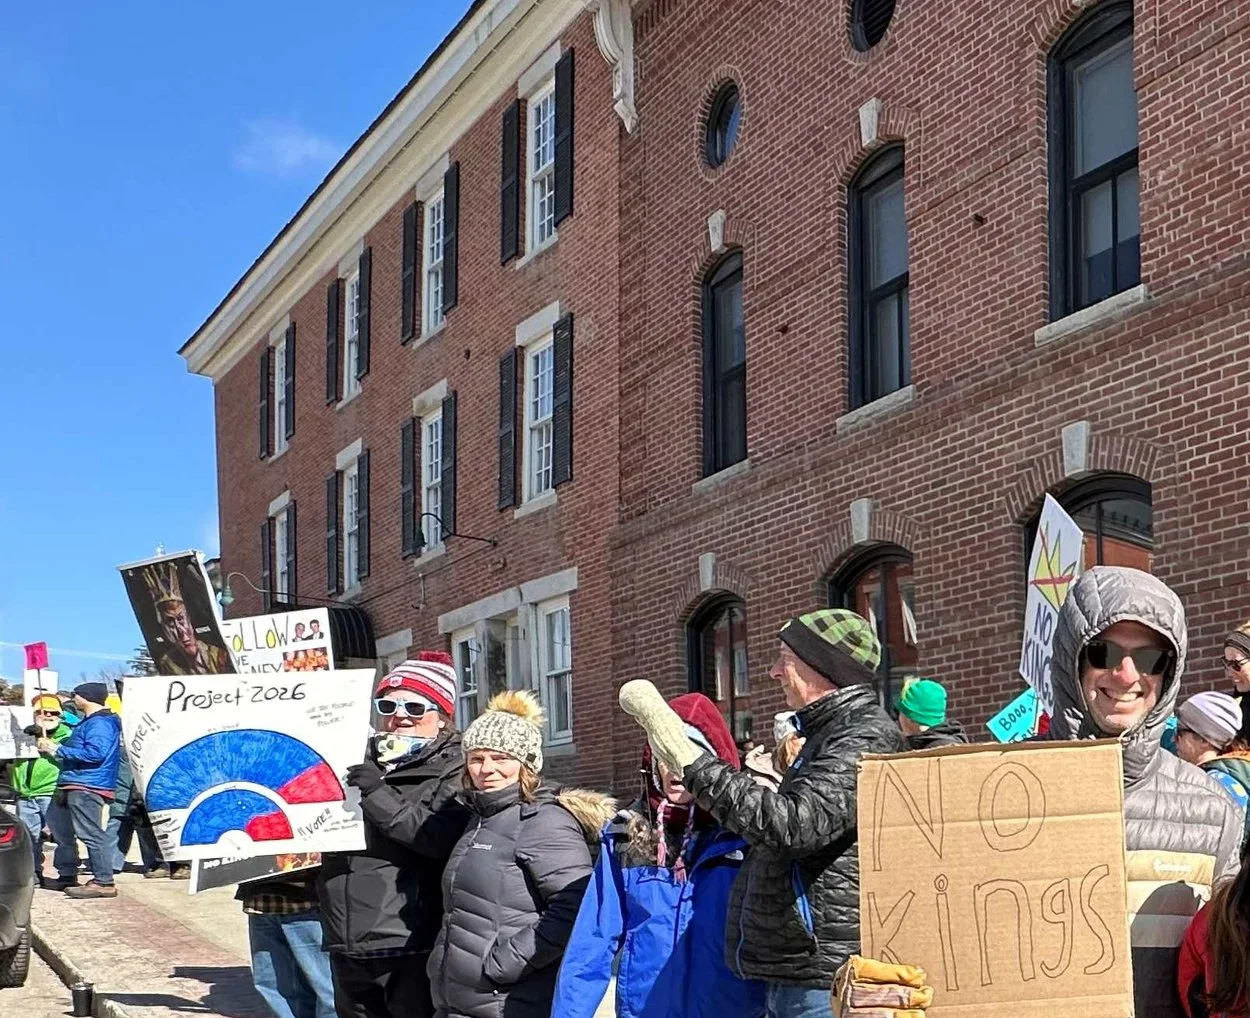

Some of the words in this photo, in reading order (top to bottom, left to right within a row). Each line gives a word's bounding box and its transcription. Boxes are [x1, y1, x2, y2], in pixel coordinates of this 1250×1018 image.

[1034, 602, 1053, 647] NO
[166, 680, 244, 714] Project
[251, 682, 307, 703] 2026
[872, 757, 1047, 872] NO
